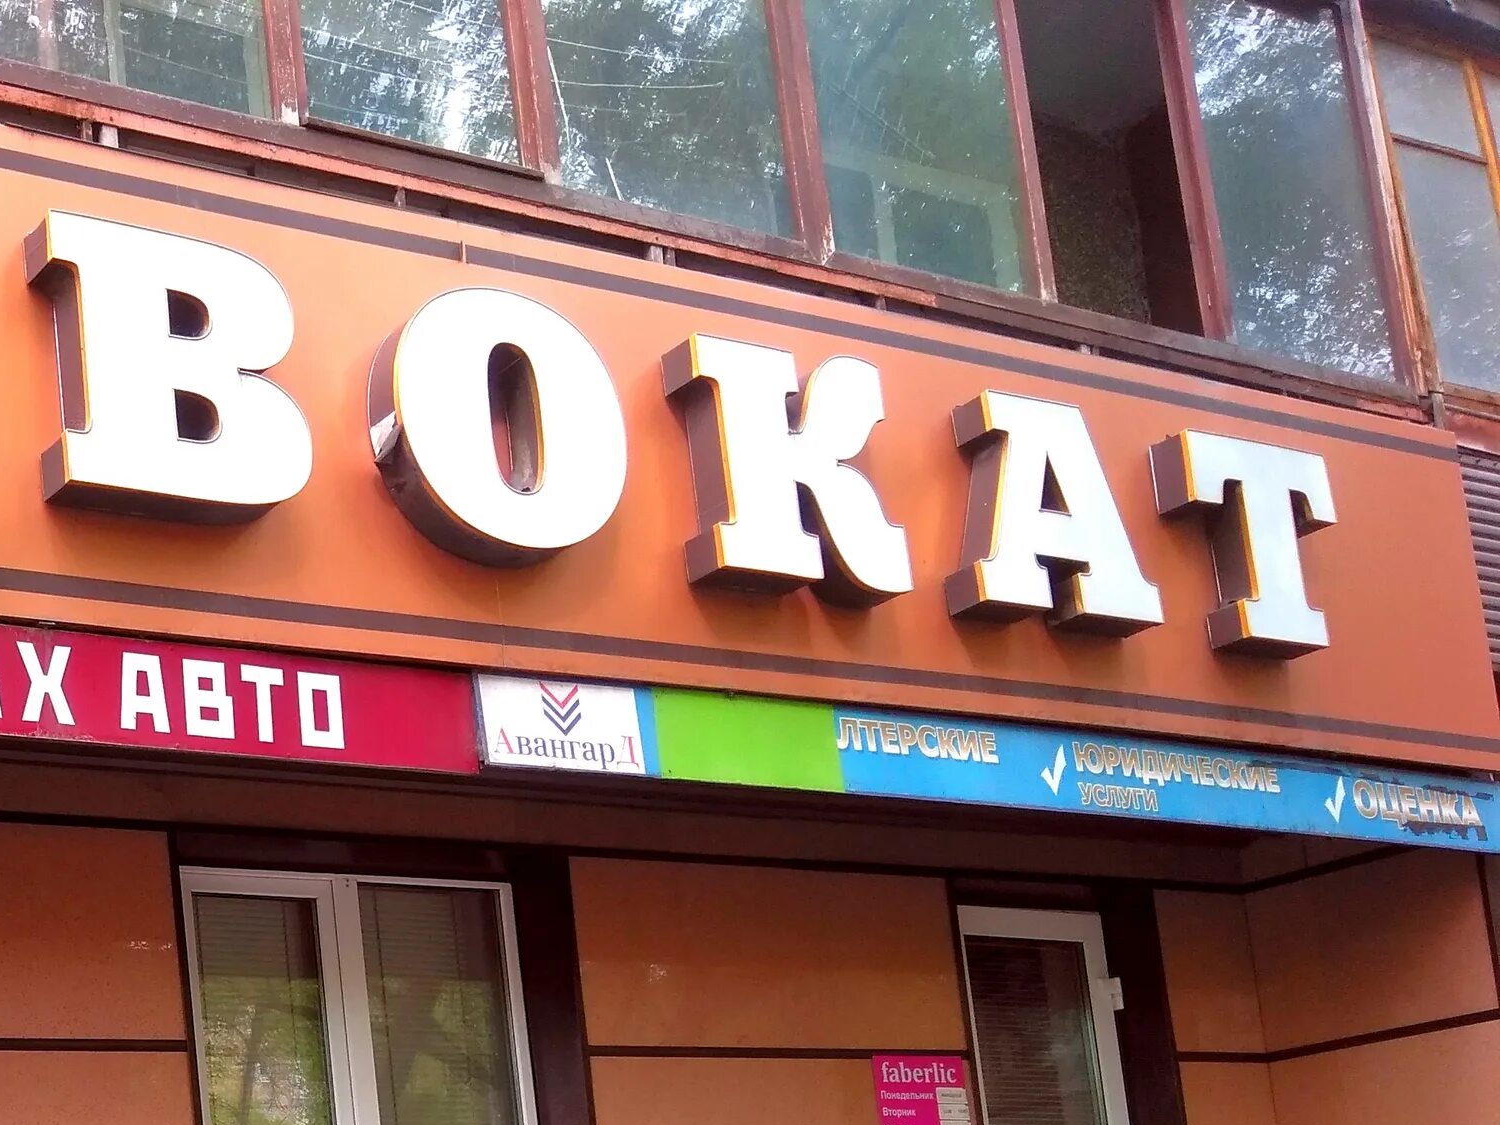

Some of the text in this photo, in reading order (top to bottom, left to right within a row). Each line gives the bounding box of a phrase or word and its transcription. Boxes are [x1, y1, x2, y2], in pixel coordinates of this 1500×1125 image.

[120, 652, 345, 751] АВТО
[493, 727, 640, 770] АвангарД
[1072, 741, 1281, 794] ЮРИДИЧЕСКИЕ
[1077, 782, 1159, 811] УСЛУГИ
[1352, 779, 1483, 830] ОЦЕНКА
[881, 1062, 957, 1084] faberlic
[880, 1090, 934, 1101] Понедельник
[882, 1107, 916, 1118] Вторник
